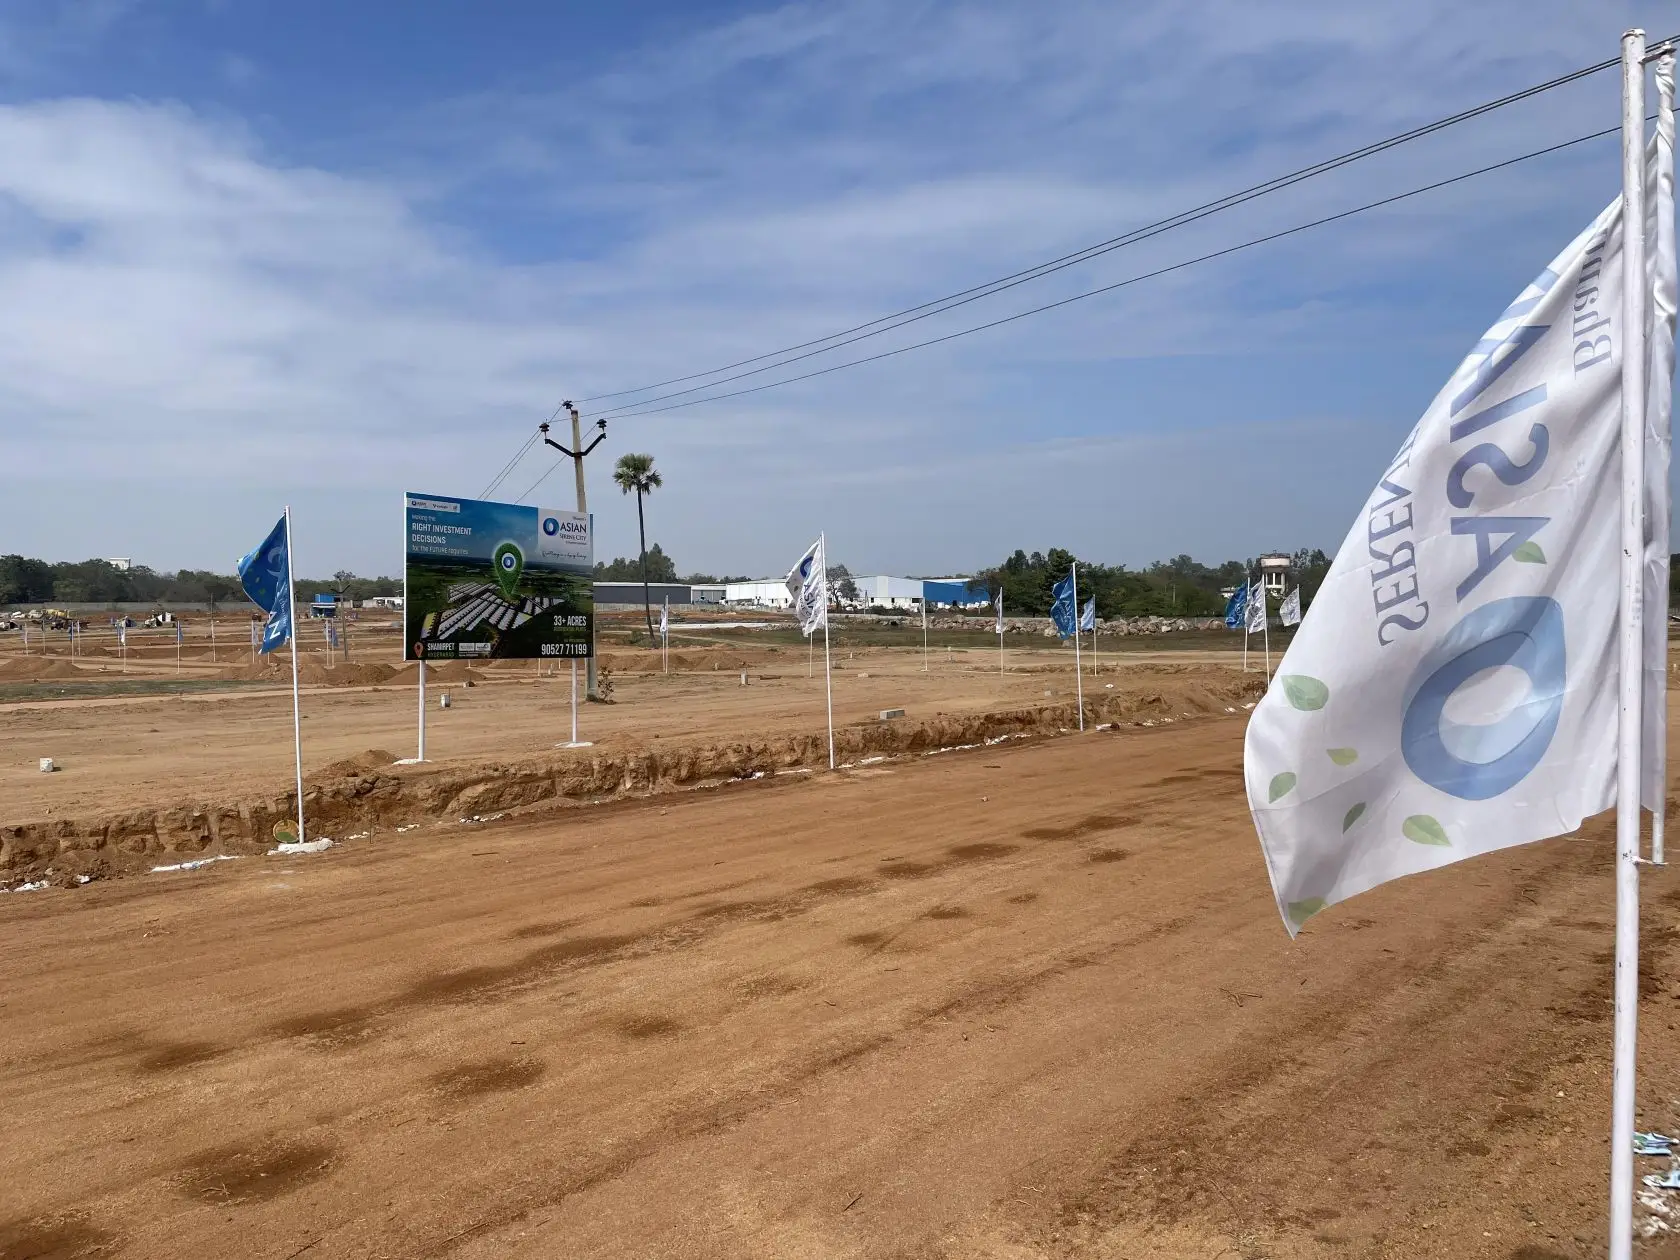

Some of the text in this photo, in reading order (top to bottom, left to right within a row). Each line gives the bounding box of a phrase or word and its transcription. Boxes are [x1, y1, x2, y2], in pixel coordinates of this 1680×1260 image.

[412, 522, 472, 535] RIGHT INVESTMENT
[560, 521, 587, 534] ASIAN
[412, 534, 446, 544] DECISIONS
[553, 615, 587, 627] 33+ ACRES
[541, 643, 588, 655] 90527 71199
